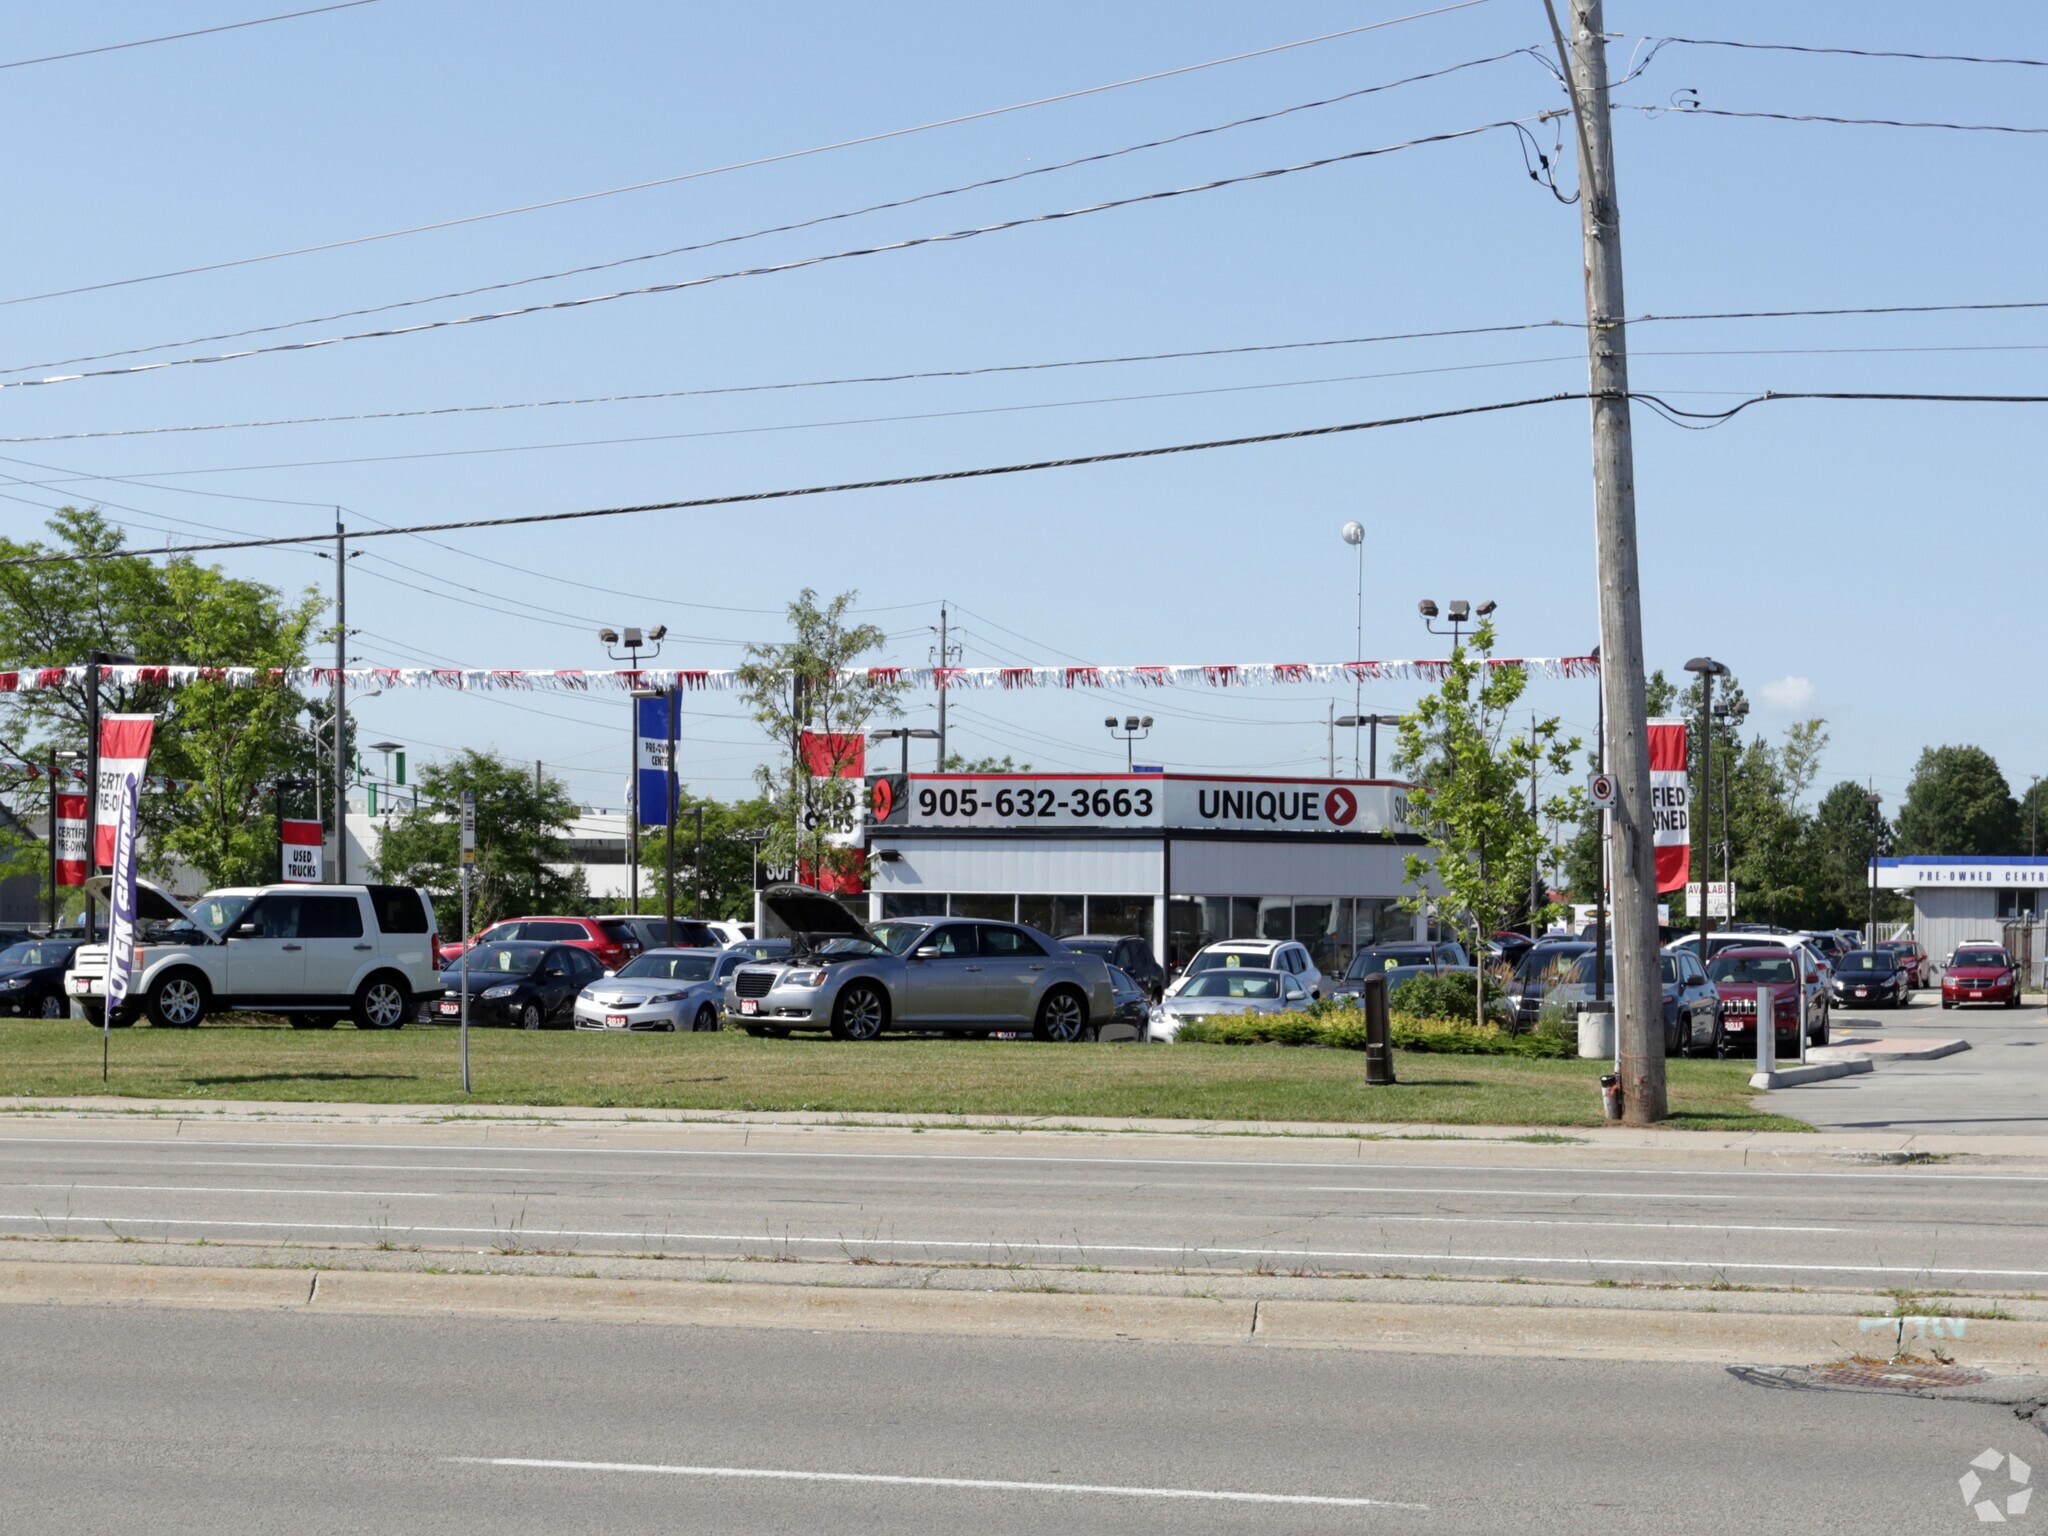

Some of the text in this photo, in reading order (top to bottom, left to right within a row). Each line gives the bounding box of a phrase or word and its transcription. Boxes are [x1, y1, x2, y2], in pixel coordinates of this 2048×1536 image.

[918, 788, 1154, 818] 905-632-3663
[1652, 786, 1686, 807] FIED
[1199, 789, 1320, 824] UNIQUE
[293, 850, 312, 863] USED
[288, 864, 316, 878] TRUCKS
[1919, 871, 2048, 883] PRE-OWNED CENTR
[1688, 884, 1734, 894] AVLABLE
[607, 1017, 626, 1026] 2012
[1724, 1021, 1744, 1030] 2015
